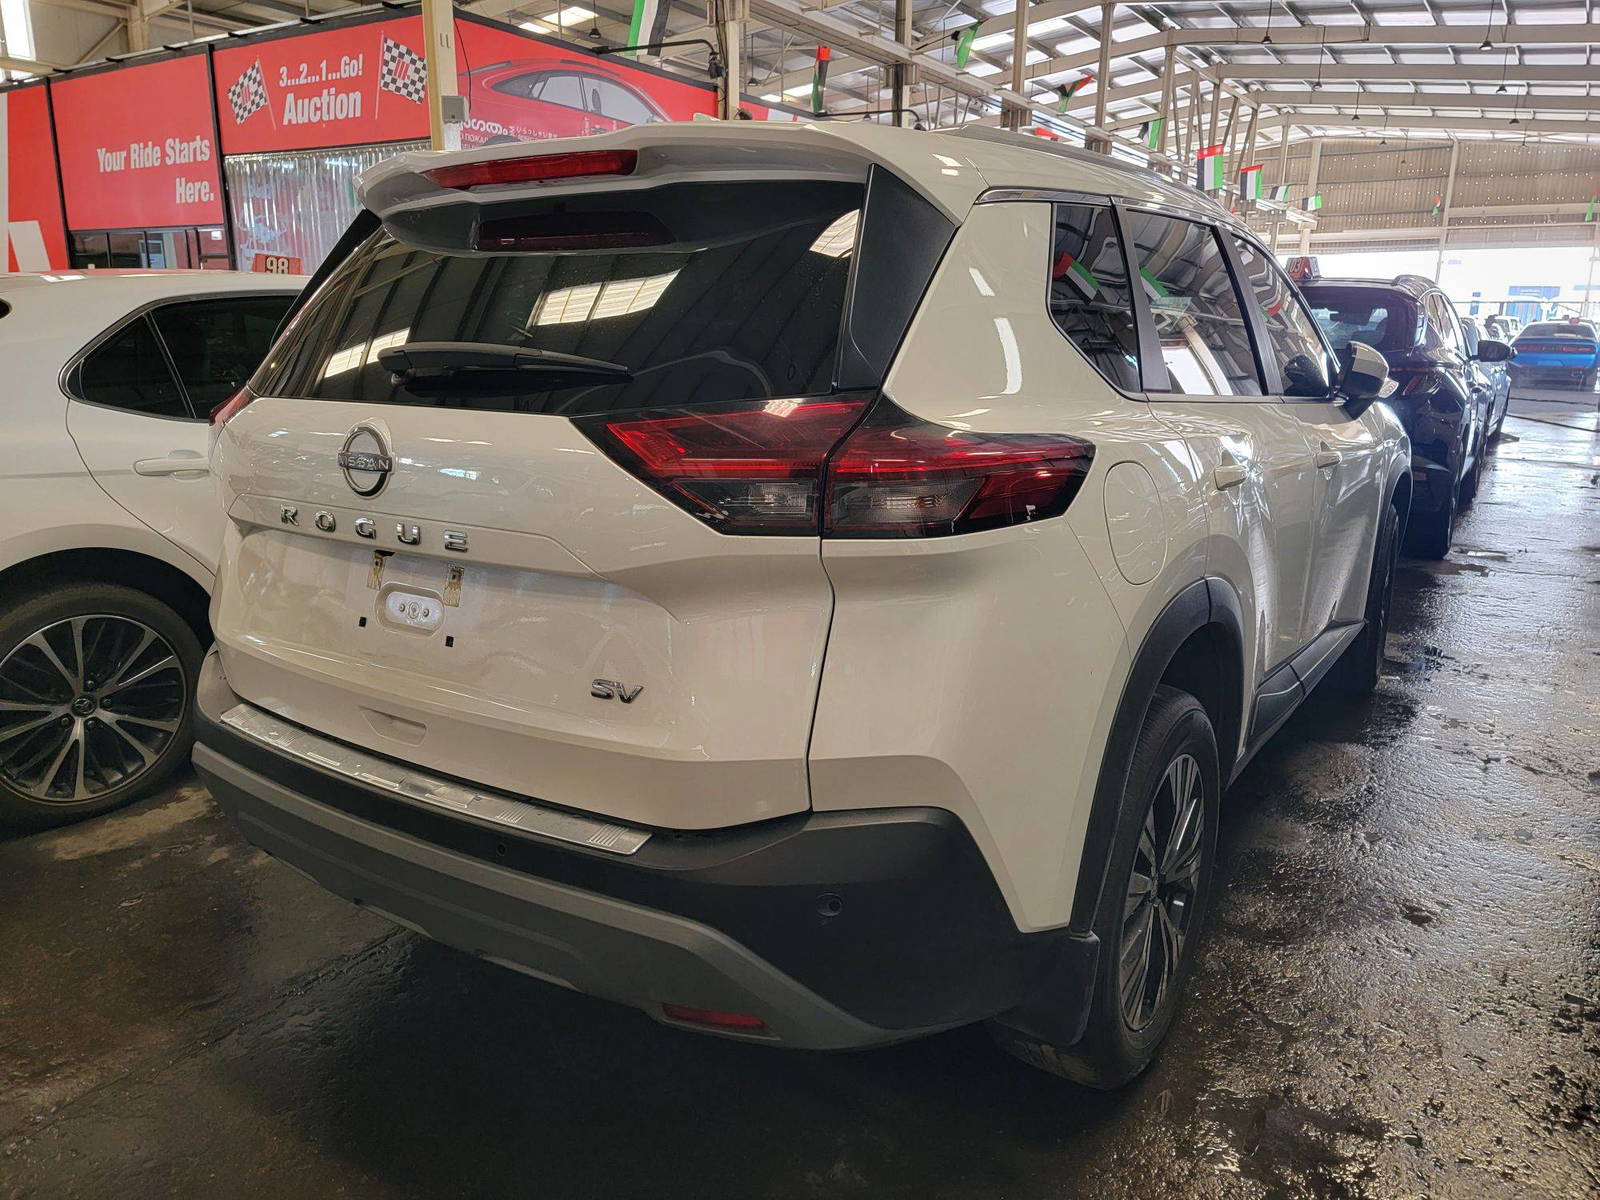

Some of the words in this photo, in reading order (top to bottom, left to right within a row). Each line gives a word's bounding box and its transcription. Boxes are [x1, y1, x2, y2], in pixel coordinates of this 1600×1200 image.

[282, 87, 362, 126] Auction
[96, 147, 127, 173] Your
[130, 141, 161, 169] Ride
[165, 135, 210, 166] Starts
[175, 177, 215, 204] Here.
[266, 256, 289, 273] 98
[280, 503, 468, 553] ROGUE
[591, 678, 644, 704] SV
